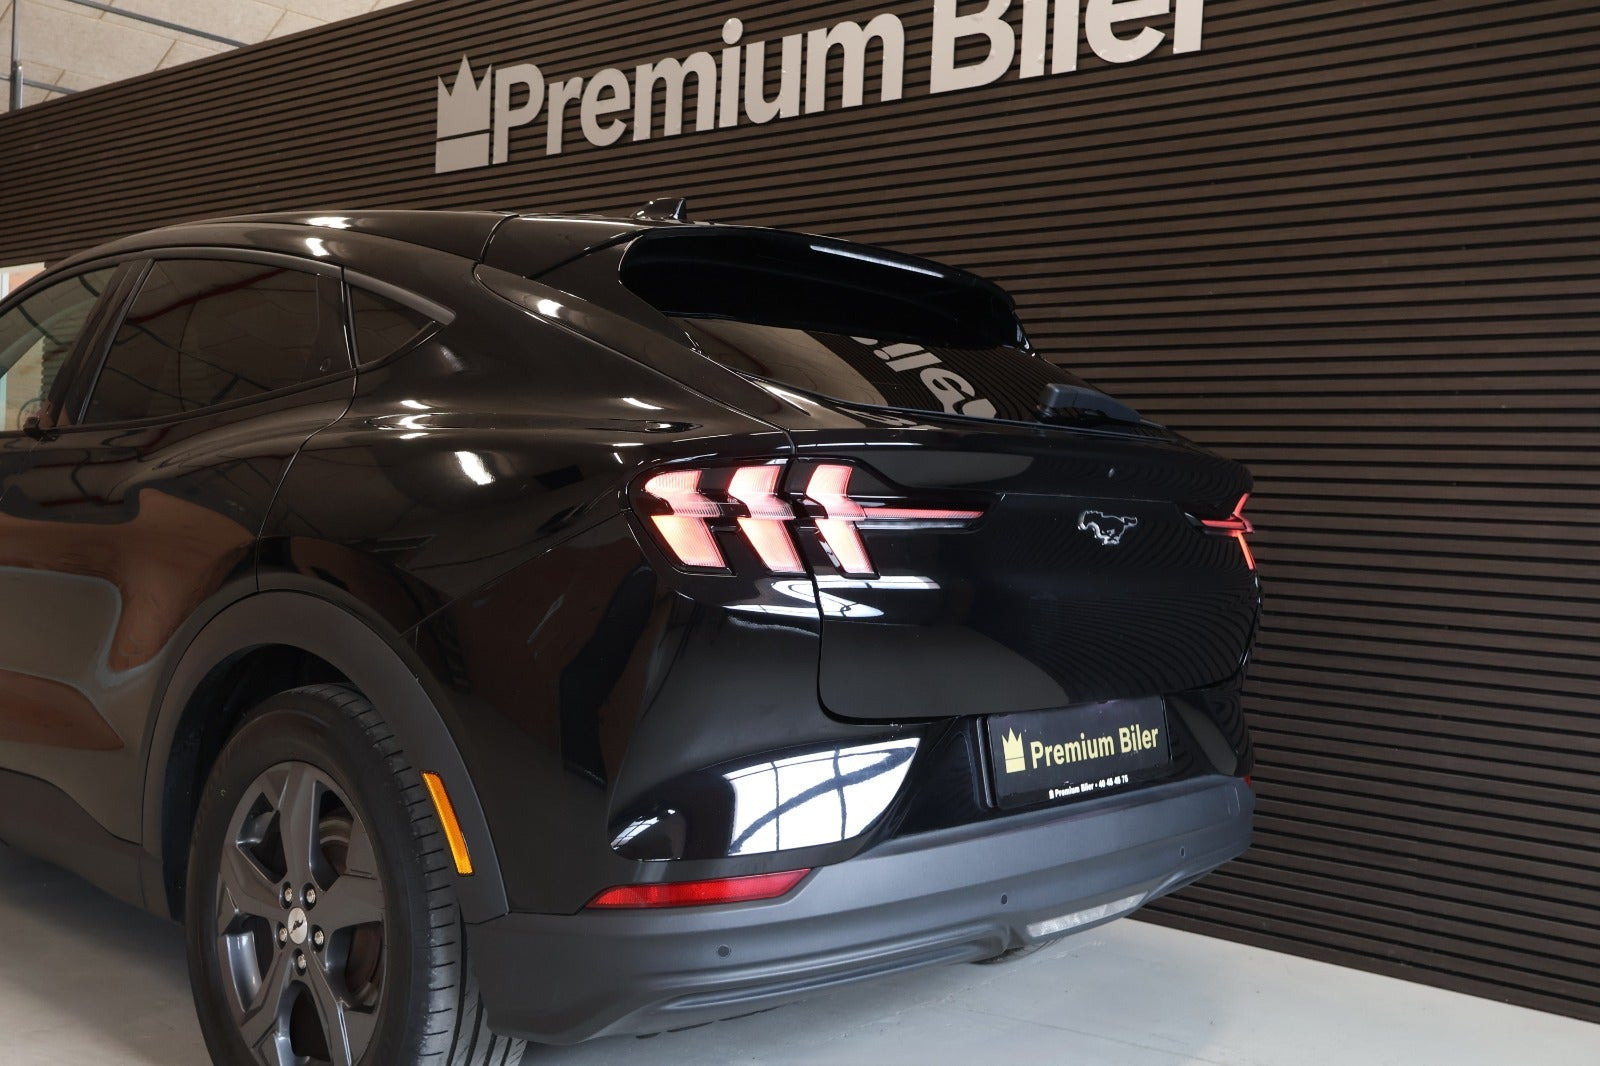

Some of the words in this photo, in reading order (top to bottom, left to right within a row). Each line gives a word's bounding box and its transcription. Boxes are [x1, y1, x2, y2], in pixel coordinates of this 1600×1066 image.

[492, 13, 905, 165] Premium
[1030, 732, 1115, 769] Premium
[1118, 723, 1158, 754] Biler
[1054, 786, 1080, 798] Premium
[1080, 783, 1094, 792] Biler
